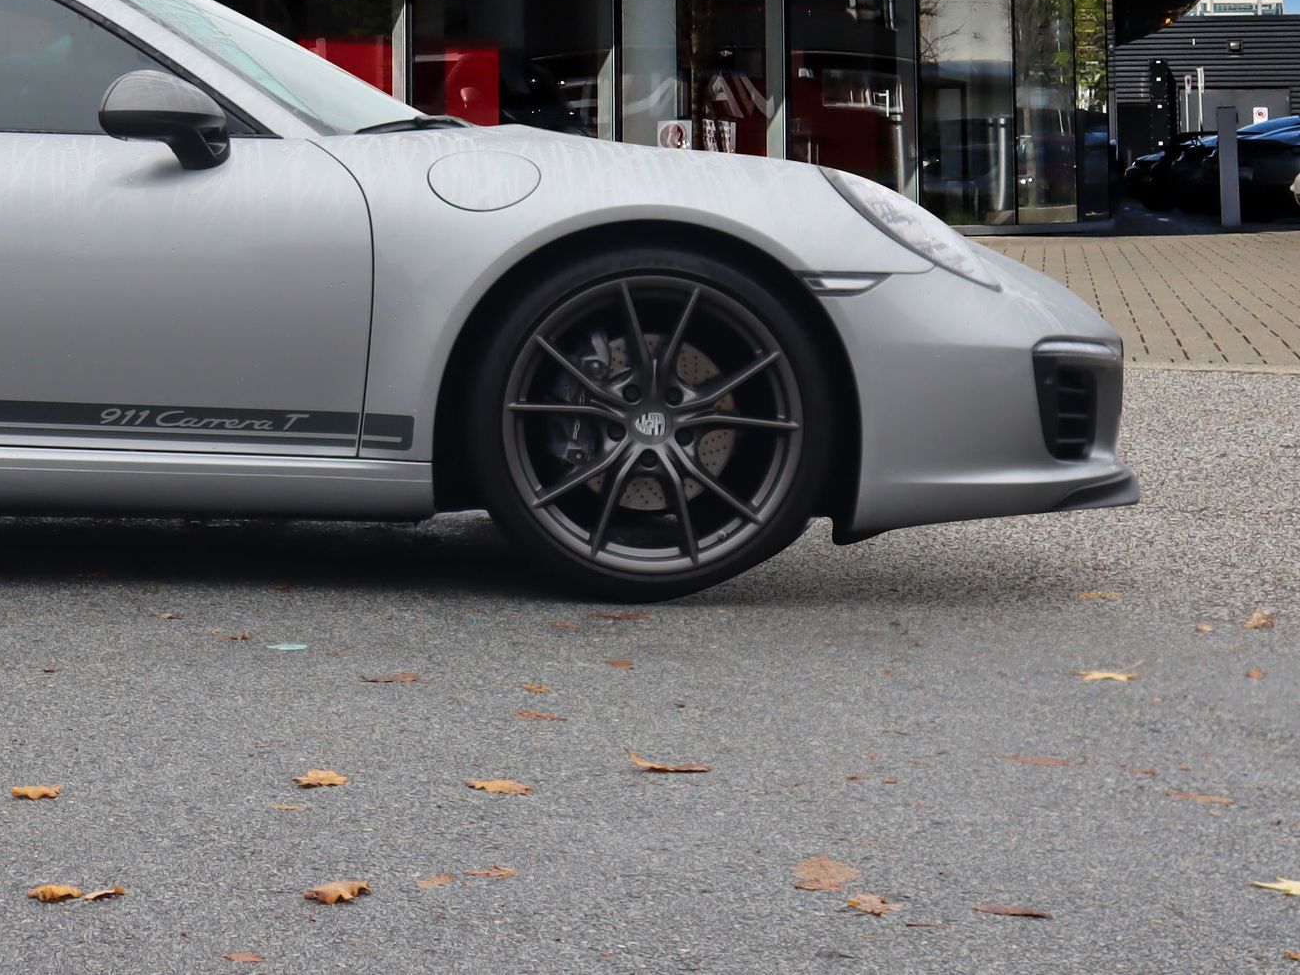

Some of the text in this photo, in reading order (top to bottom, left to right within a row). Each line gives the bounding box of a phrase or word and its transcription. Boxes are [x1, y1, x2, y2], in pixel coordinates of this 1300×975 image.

[100, 408, 310, 431] 911 Carrera T
